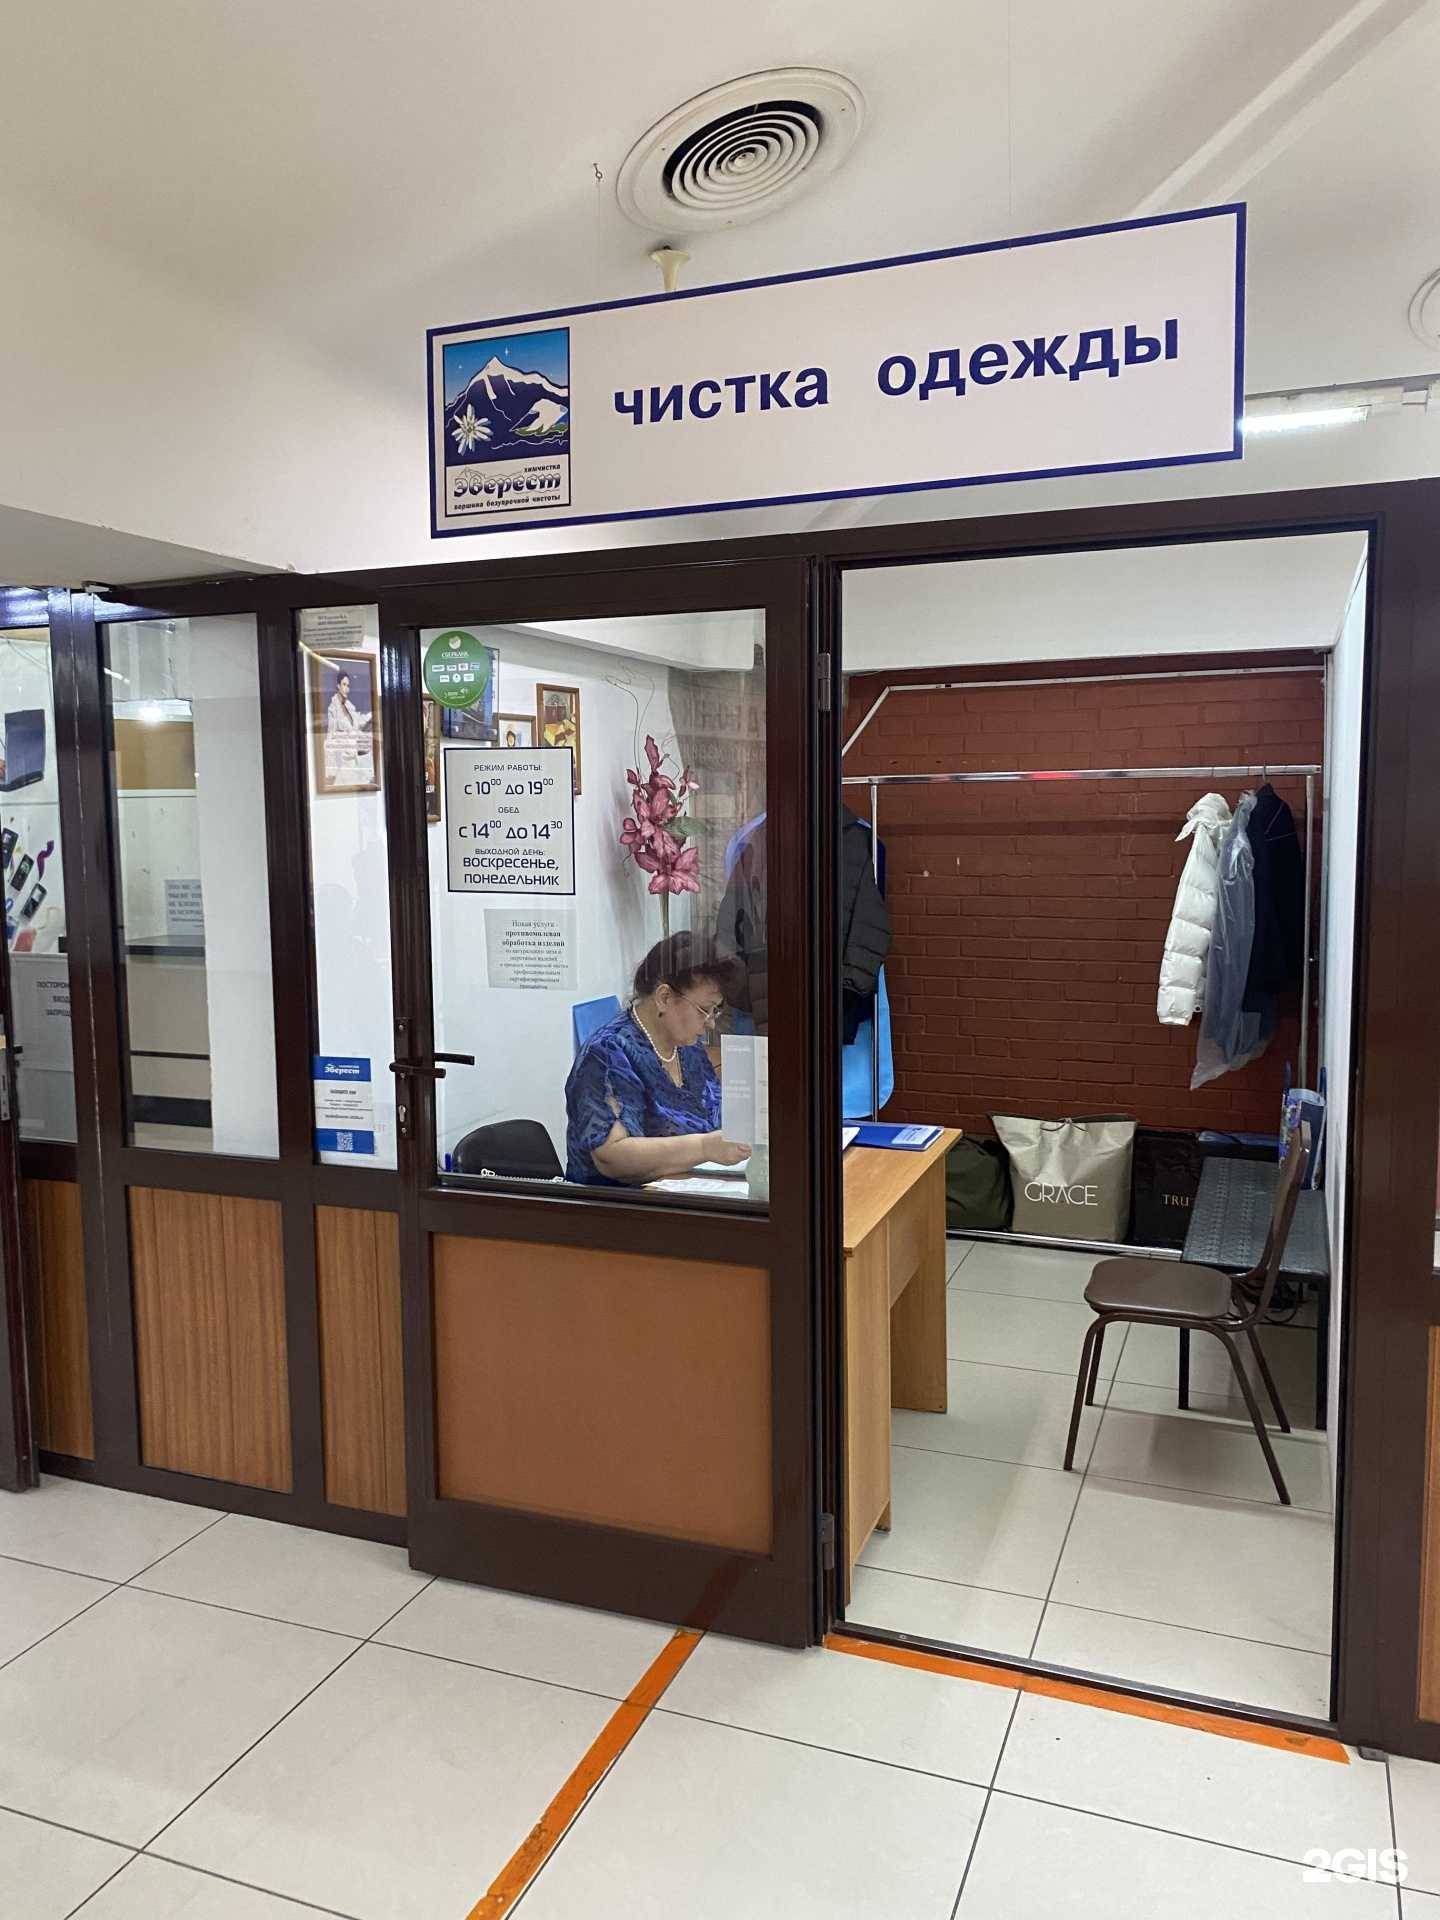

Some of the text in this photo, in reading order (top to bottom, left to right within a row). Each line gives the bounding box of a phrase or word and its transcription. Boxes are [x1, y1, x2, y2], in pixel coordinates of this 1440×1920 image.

[614, 319, 1179, 425] чистка одежды
[453, 473, 562, 499] Эверест
[474, 764, 504, 772] РЕЖИМ
[475, 848, 520, 856] ВЫХОДНОЙ
[1024, 1181, 1099, 1206] GRACE
